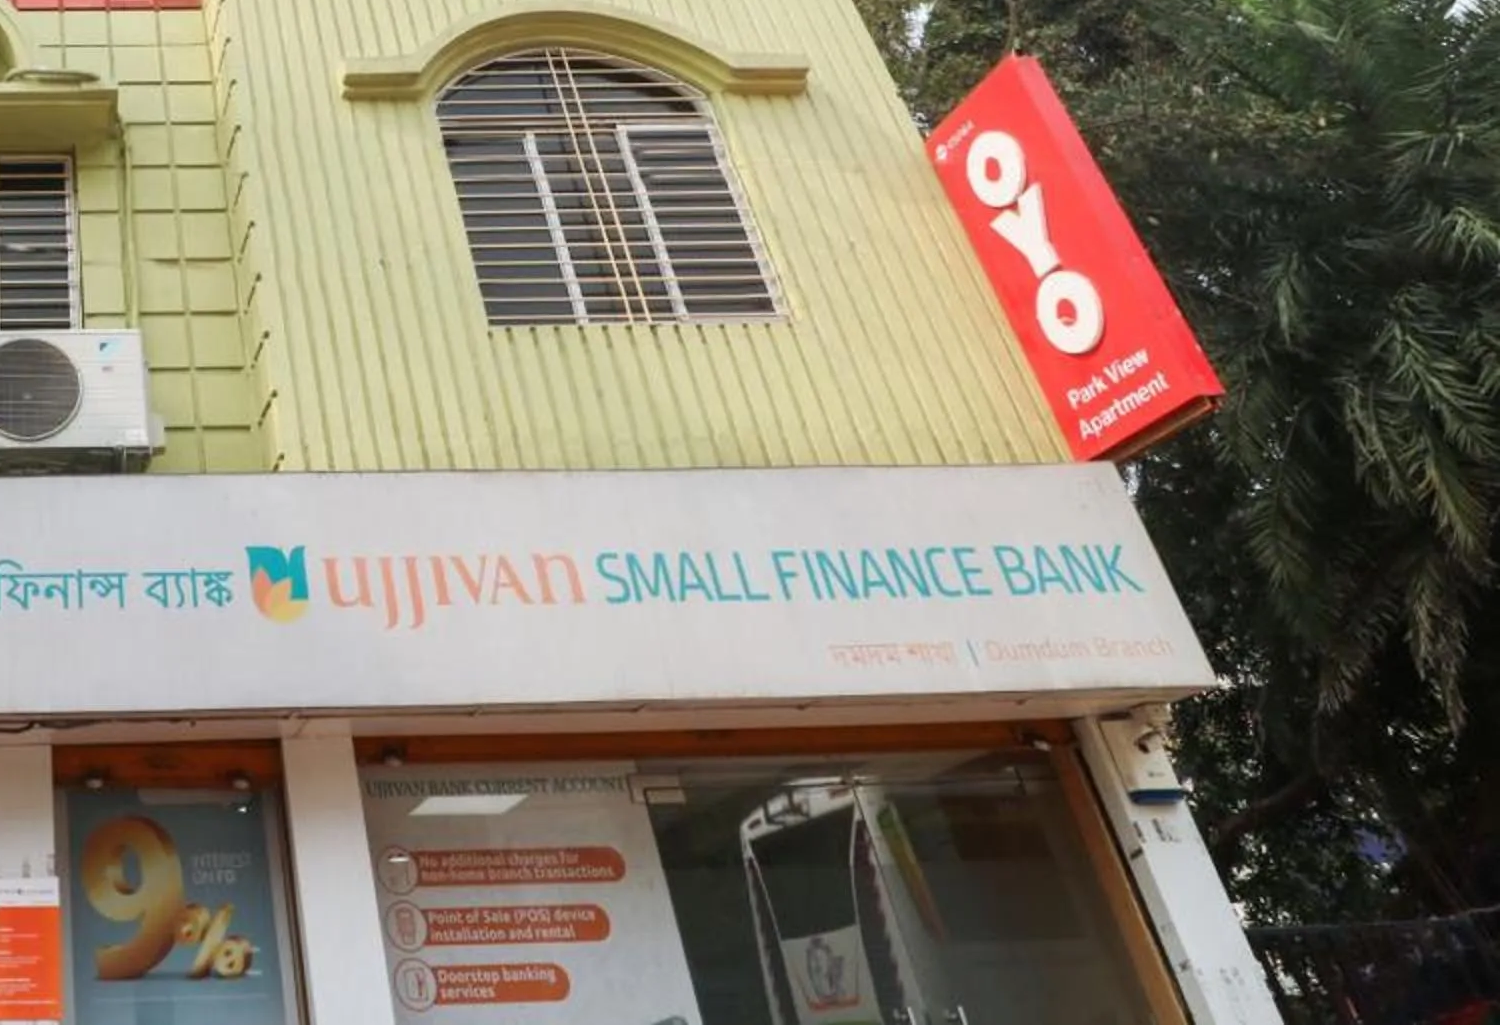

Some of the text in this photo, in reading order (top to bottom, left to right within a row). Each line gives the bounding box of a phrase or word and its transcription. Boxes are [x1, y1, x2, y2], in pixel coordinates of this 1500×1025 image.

[966, 130, 1105, 355] OYO
[1066, 348, 1149, 410] Park View
[1079, 371, 1170, 441] Apartment
[142, 567, 234, 609] ব্যাঙ্ক
[595, 550, 769, 605] SMALL
[770, 546, 993, 602] FINANCE
[994, 544, 1145, 596] BANK
[1092, 636, 1174, 658] Branch
[428, 911, 463, 924] Point
[466, 910, 479, 923] of
[483, 909, 510, 923] Sale
[553, 907, 596, 922] device
[430, 925, 576, 942] installation and rental
[437, 965, 556, 984] Doorstep banking
[439, 985, 496, 999] services
